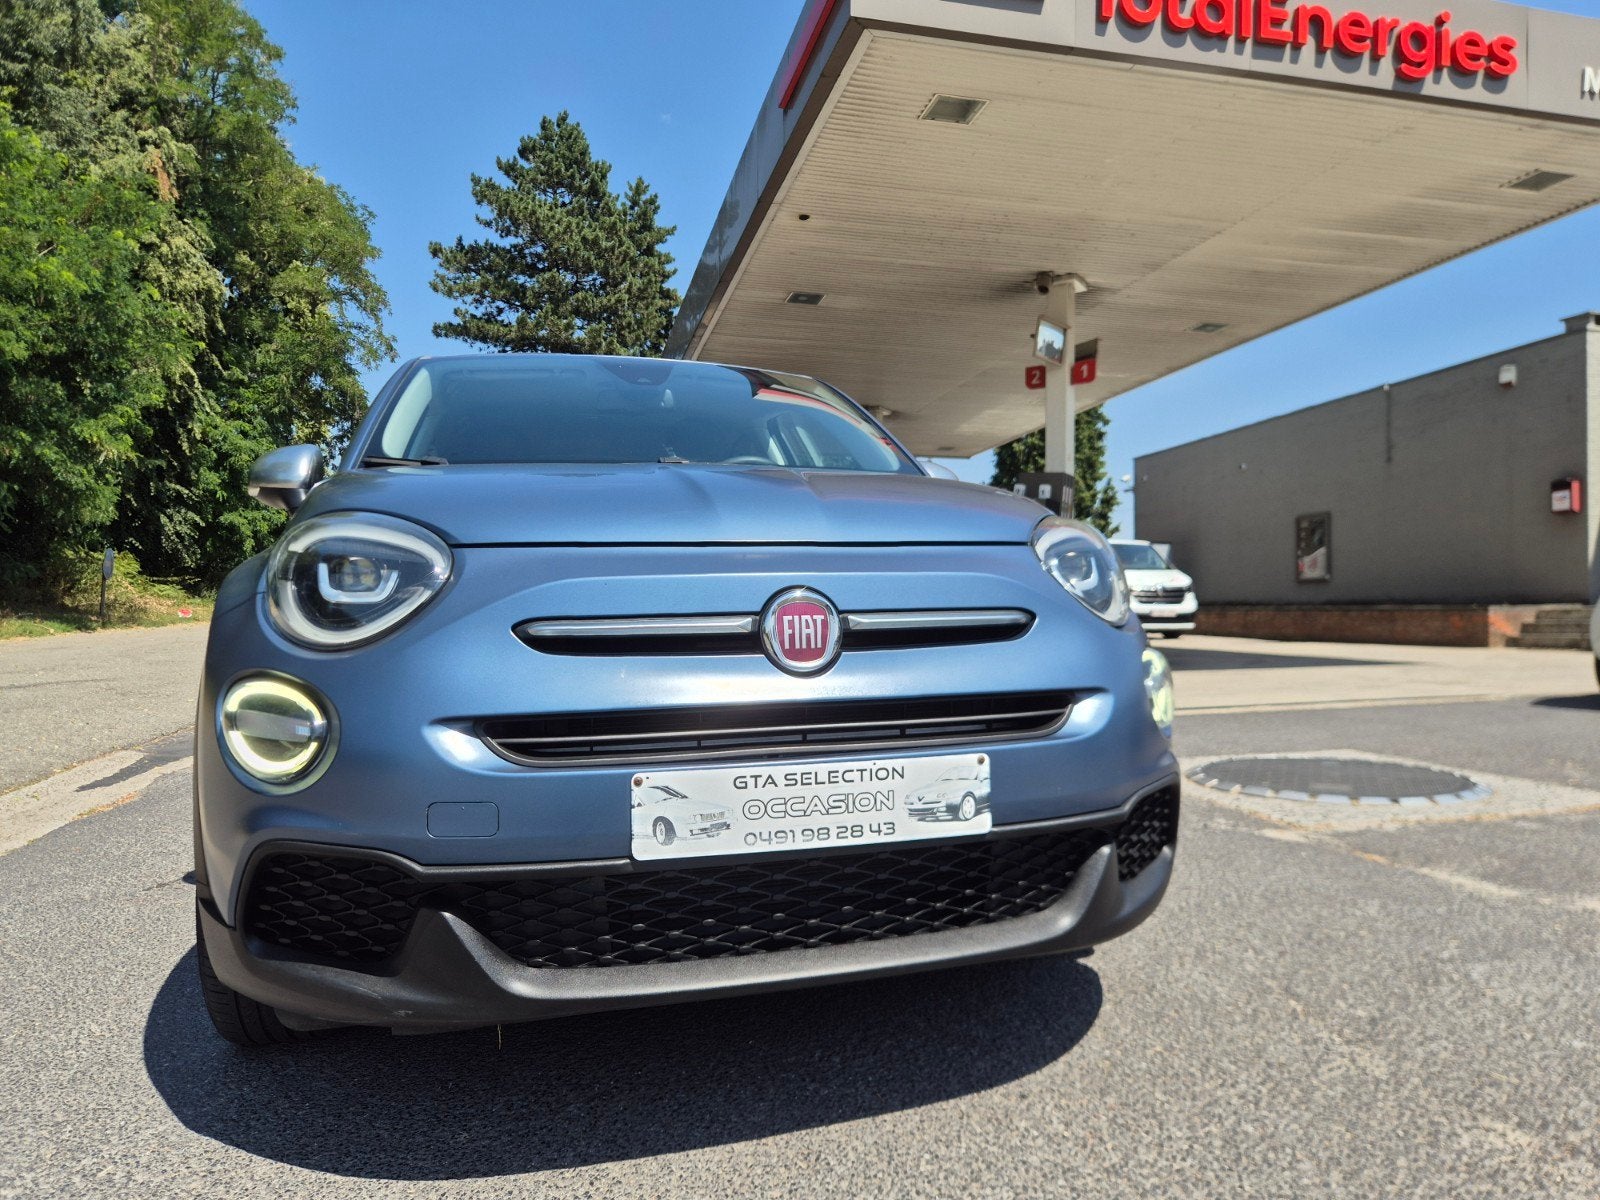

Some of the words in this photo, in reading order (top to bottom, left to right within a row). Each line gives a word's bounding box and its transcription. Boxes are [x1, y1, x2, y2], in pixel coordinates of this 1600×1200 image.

[1031, 370, 1041, 385] 2
[1079, 363, 1089, 379] 1
[782, 614, 825, 650] FIAT
[733, 773, 779, 790] GTA
[783, 765, 905, 787] SELECTION
[742, 789, 895, 821] OCCASION
[743, 829, 796, 847] 0491
[801, 826, 831, 843] 98
[836, 824, 864, 840] 28
[869, 821, 896, 836] 43
